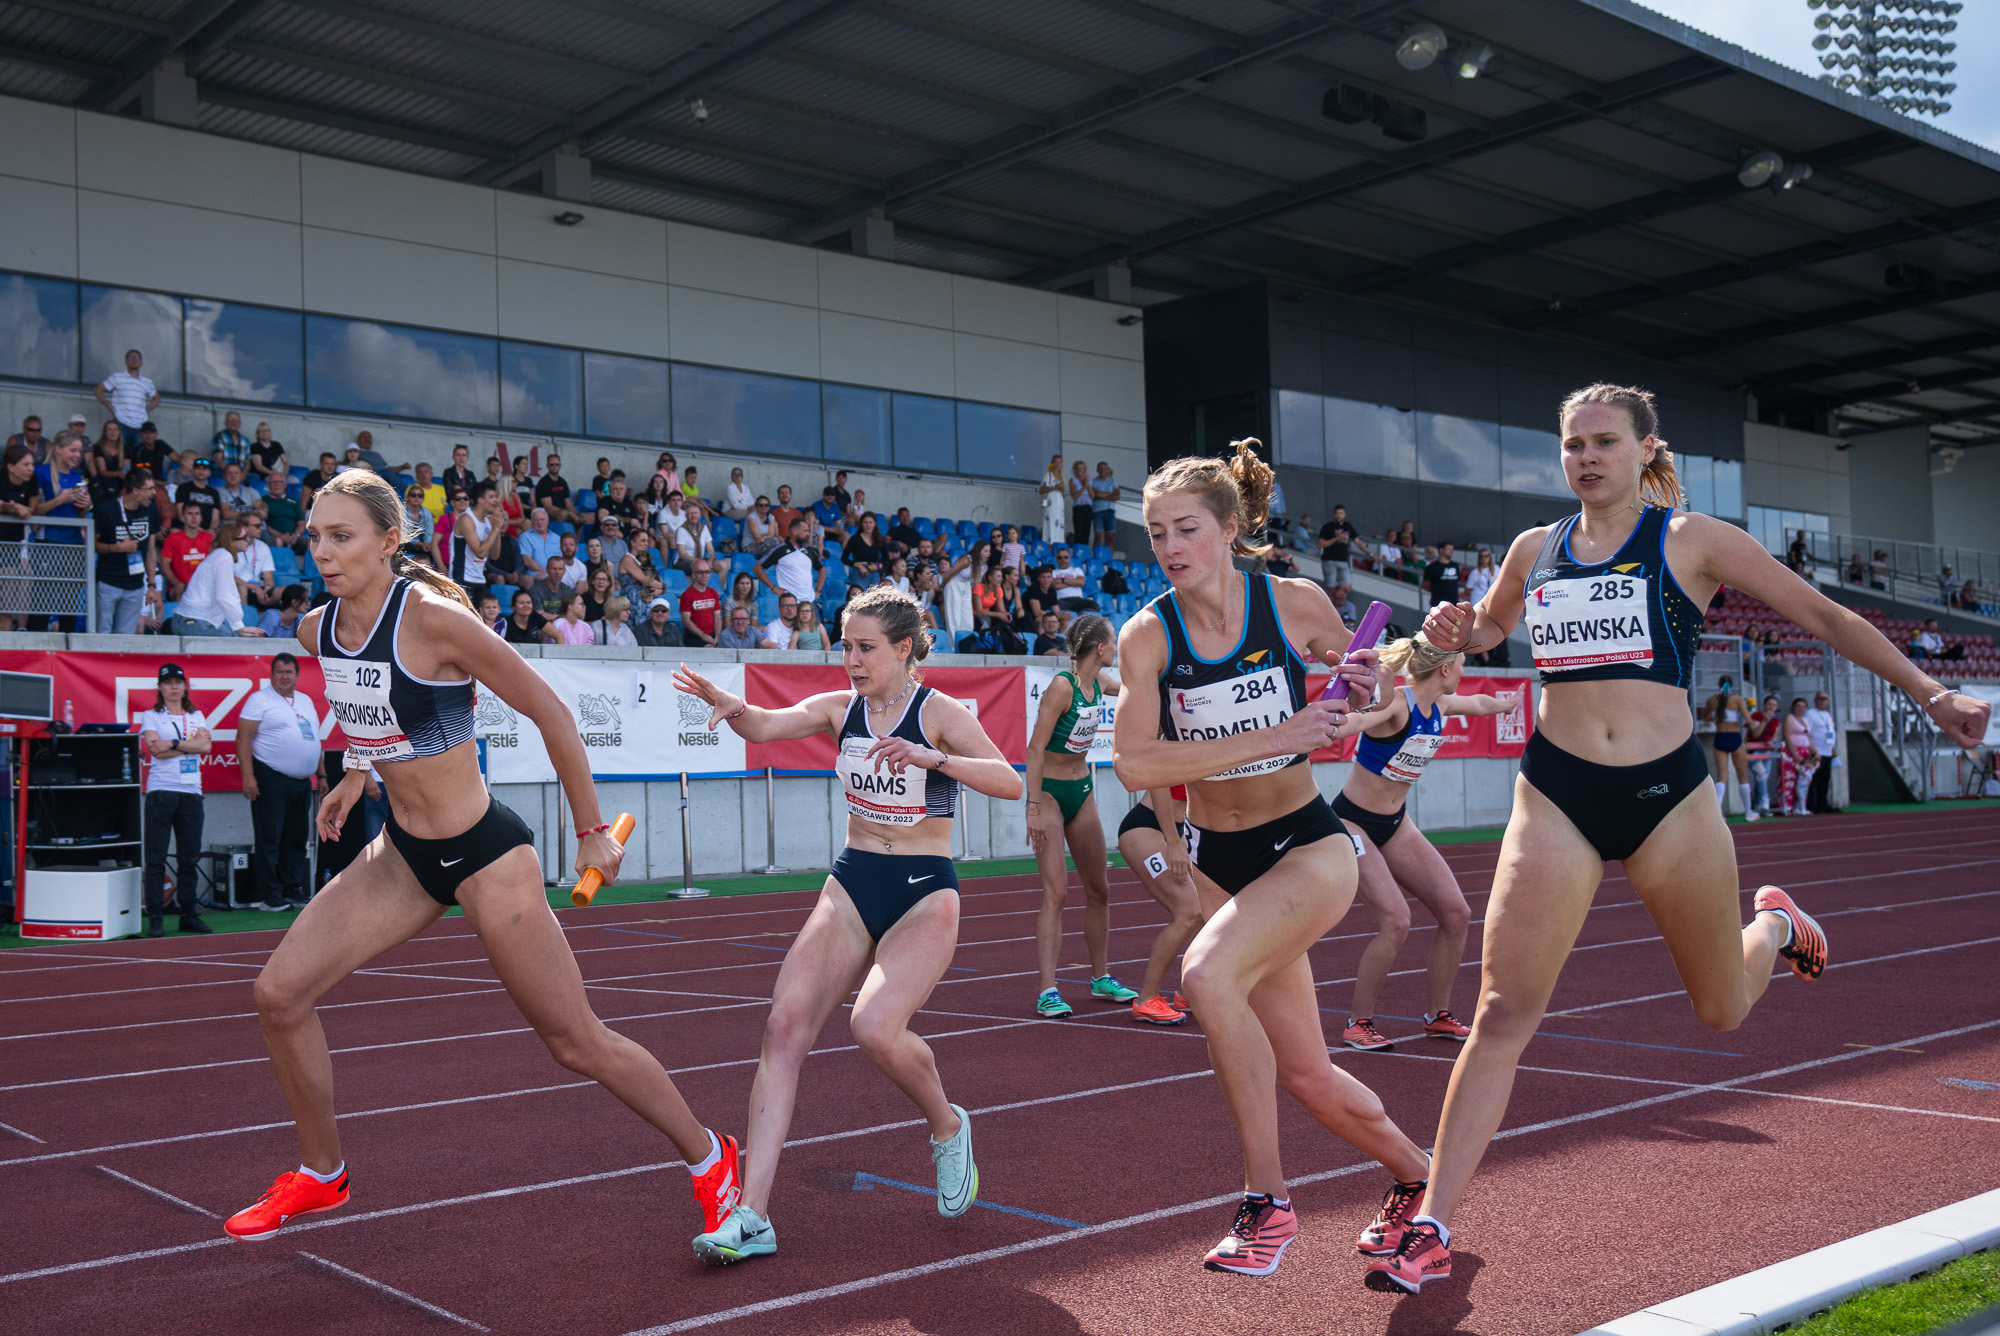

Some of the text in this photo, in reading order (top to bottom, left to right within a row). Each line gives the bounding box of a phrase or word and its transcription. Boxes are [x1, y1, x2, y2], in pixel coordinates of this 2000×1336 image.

[1589, 580, 1634, 601] 285
[1532, 616, 1645, 646] GAJEWSKA
[1563, 655, 1604, 665] Mistrzostwa
[1606, 652, 1628, 662] Polski
[1629, 651, 1645, 659] U23
[356, 666, 381, 688] 102
[639, 683, 646, 702] 2
[1031, 684, 1039, 700] 4
[1231, 675, 1278, 704] 284
[1186, 700, 1212, 708] POMORZE
[375, 746, 398, 755] 2023
[1266, 756, 1290, 769] 2023
[851, 772, 907, 796] DAMS
[851, 805, 892, 822] WŁOCŁAWEK
[238, 857, 244, 866] 6
[1150, 856, 1163, 873] 6
